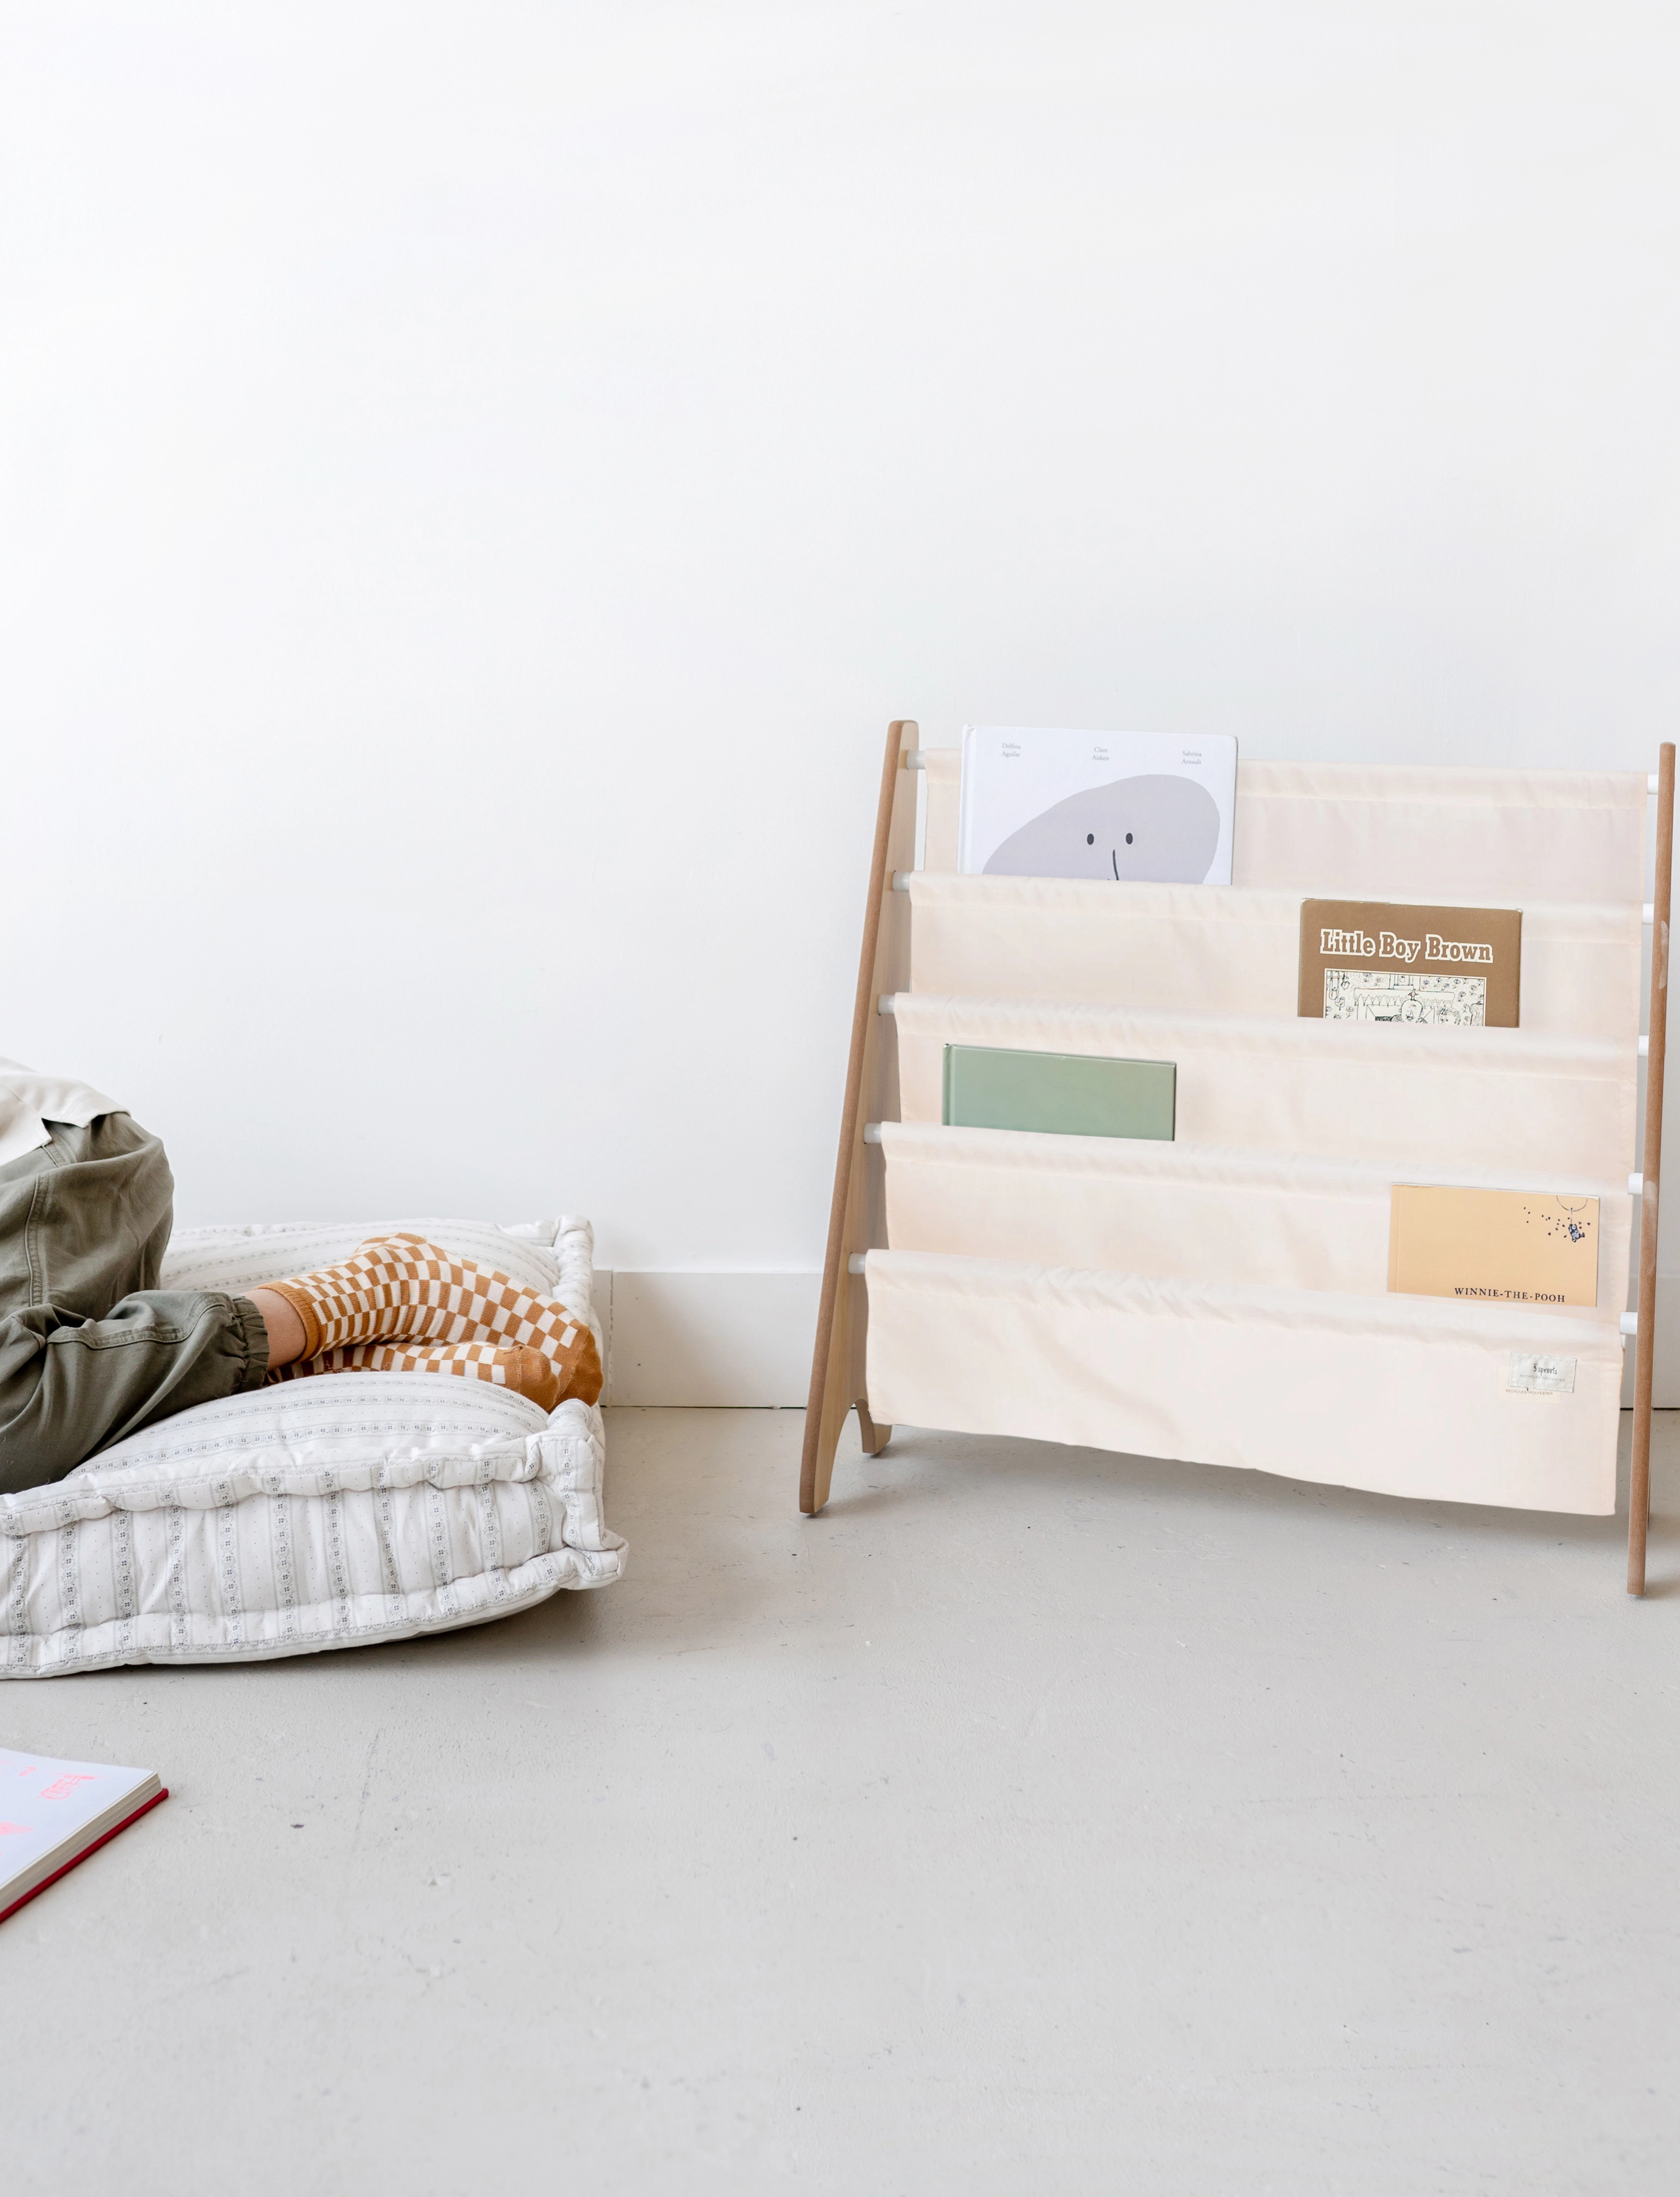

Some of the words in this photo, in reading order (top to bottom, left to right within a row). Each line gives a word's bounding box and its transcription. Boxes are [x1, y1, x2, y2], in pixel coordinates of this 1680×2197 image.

[1320, 928, 1376, 957] Little
[1379, 931, 1421, 963] Boy
[1424, 934, 1493, 963] Brown
[1454, 1287, 1565, 1303] WINNIE-THE-POOH
[1537, 1365, 1558, 1376] sprouts
